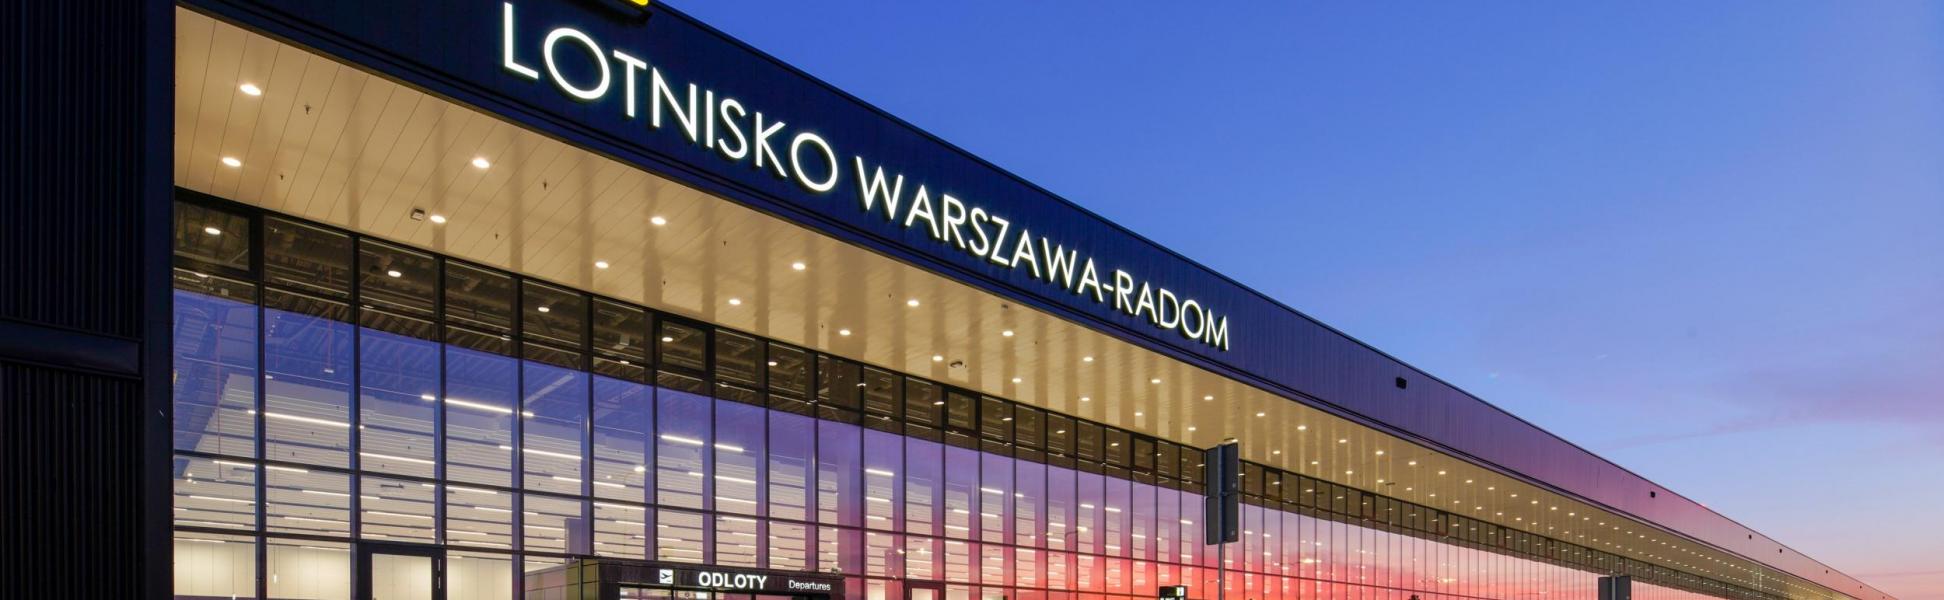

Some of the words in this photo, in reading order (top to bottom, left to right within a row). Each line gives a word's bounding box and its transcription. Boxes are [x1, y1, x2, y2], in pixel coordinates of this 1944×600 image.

[504, 2, 838, 192] LOTNISKO
[855, 155, 1229, 351] WARSZAWA-RADOM
[698, 571, 767, 590] ODLOTY
[788, 579, 832, 592] Departures
